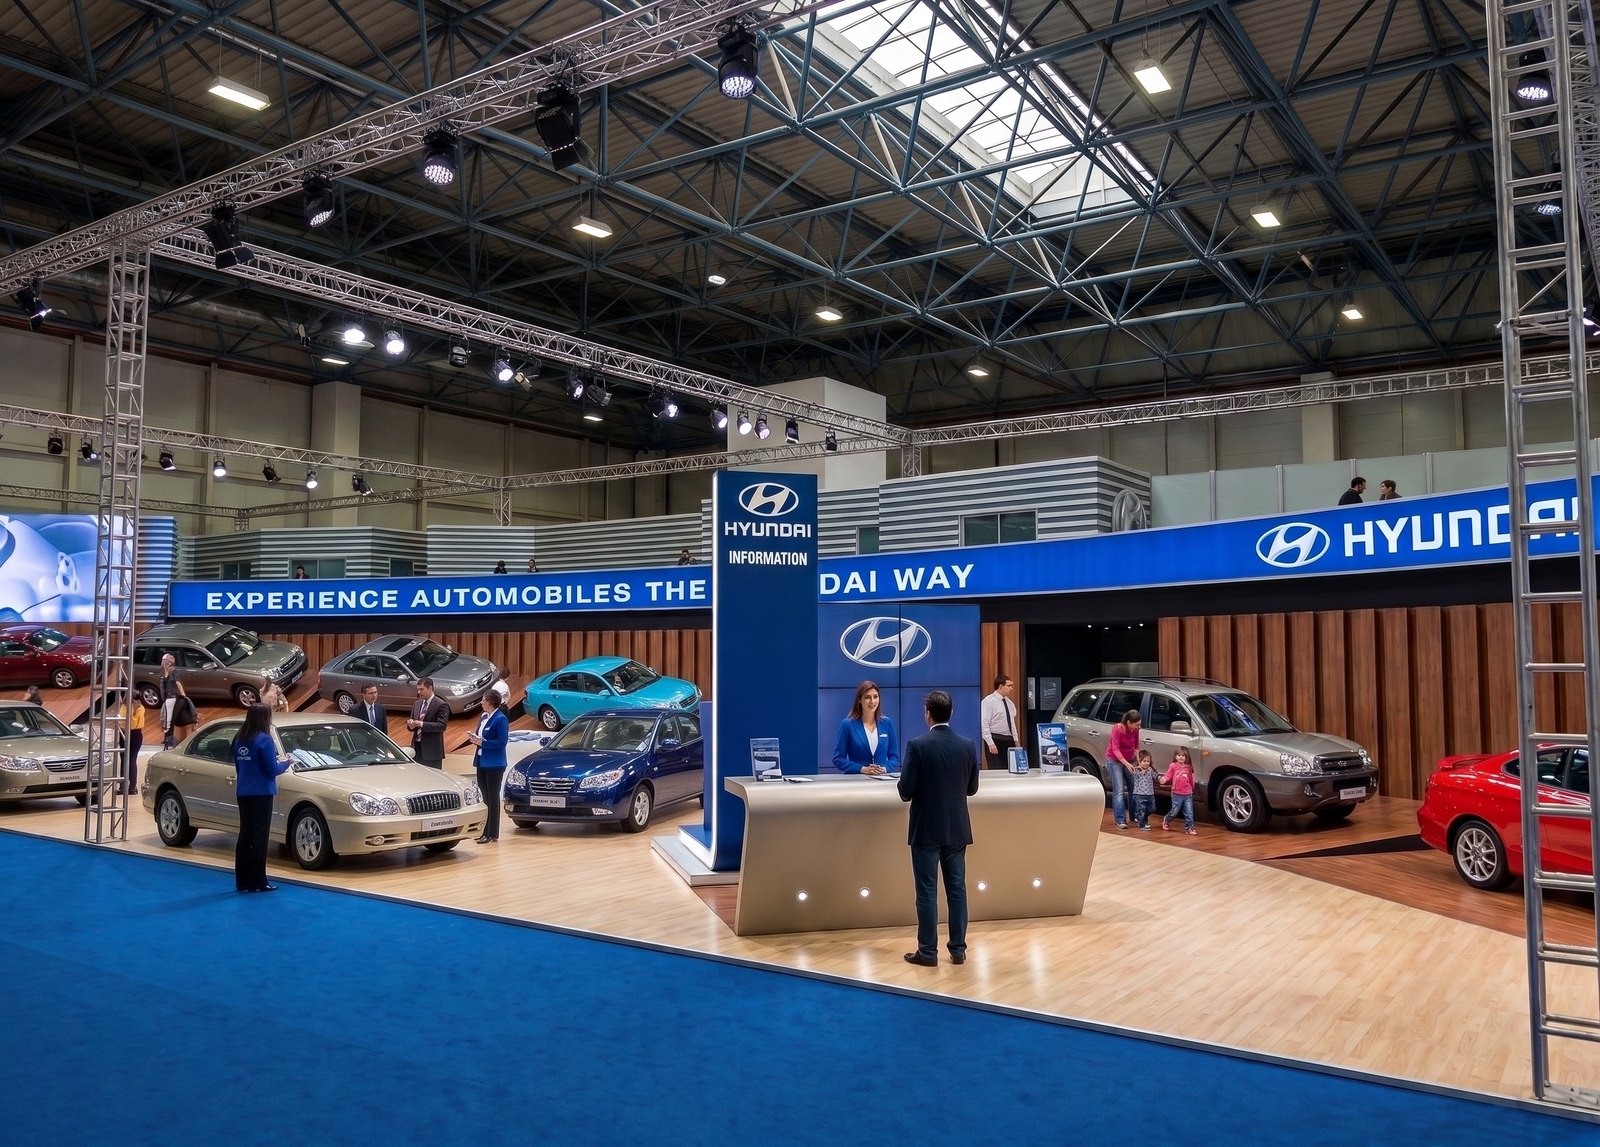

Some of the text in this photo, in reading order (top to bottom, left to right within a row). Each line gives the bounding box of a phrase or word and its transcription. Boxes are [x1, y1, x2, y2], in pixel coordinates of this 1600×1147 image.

[724, 521, 812, 538] HYUNDAI
[729, 550, 808, 566] INFORMATION
[206, 589, 398, 610] EXPERIENCE
[410, 582, 632, 608] AUTOMOBILES
[645, 579, 706, 601] THE
[893, 563, 975, 591] WAY
